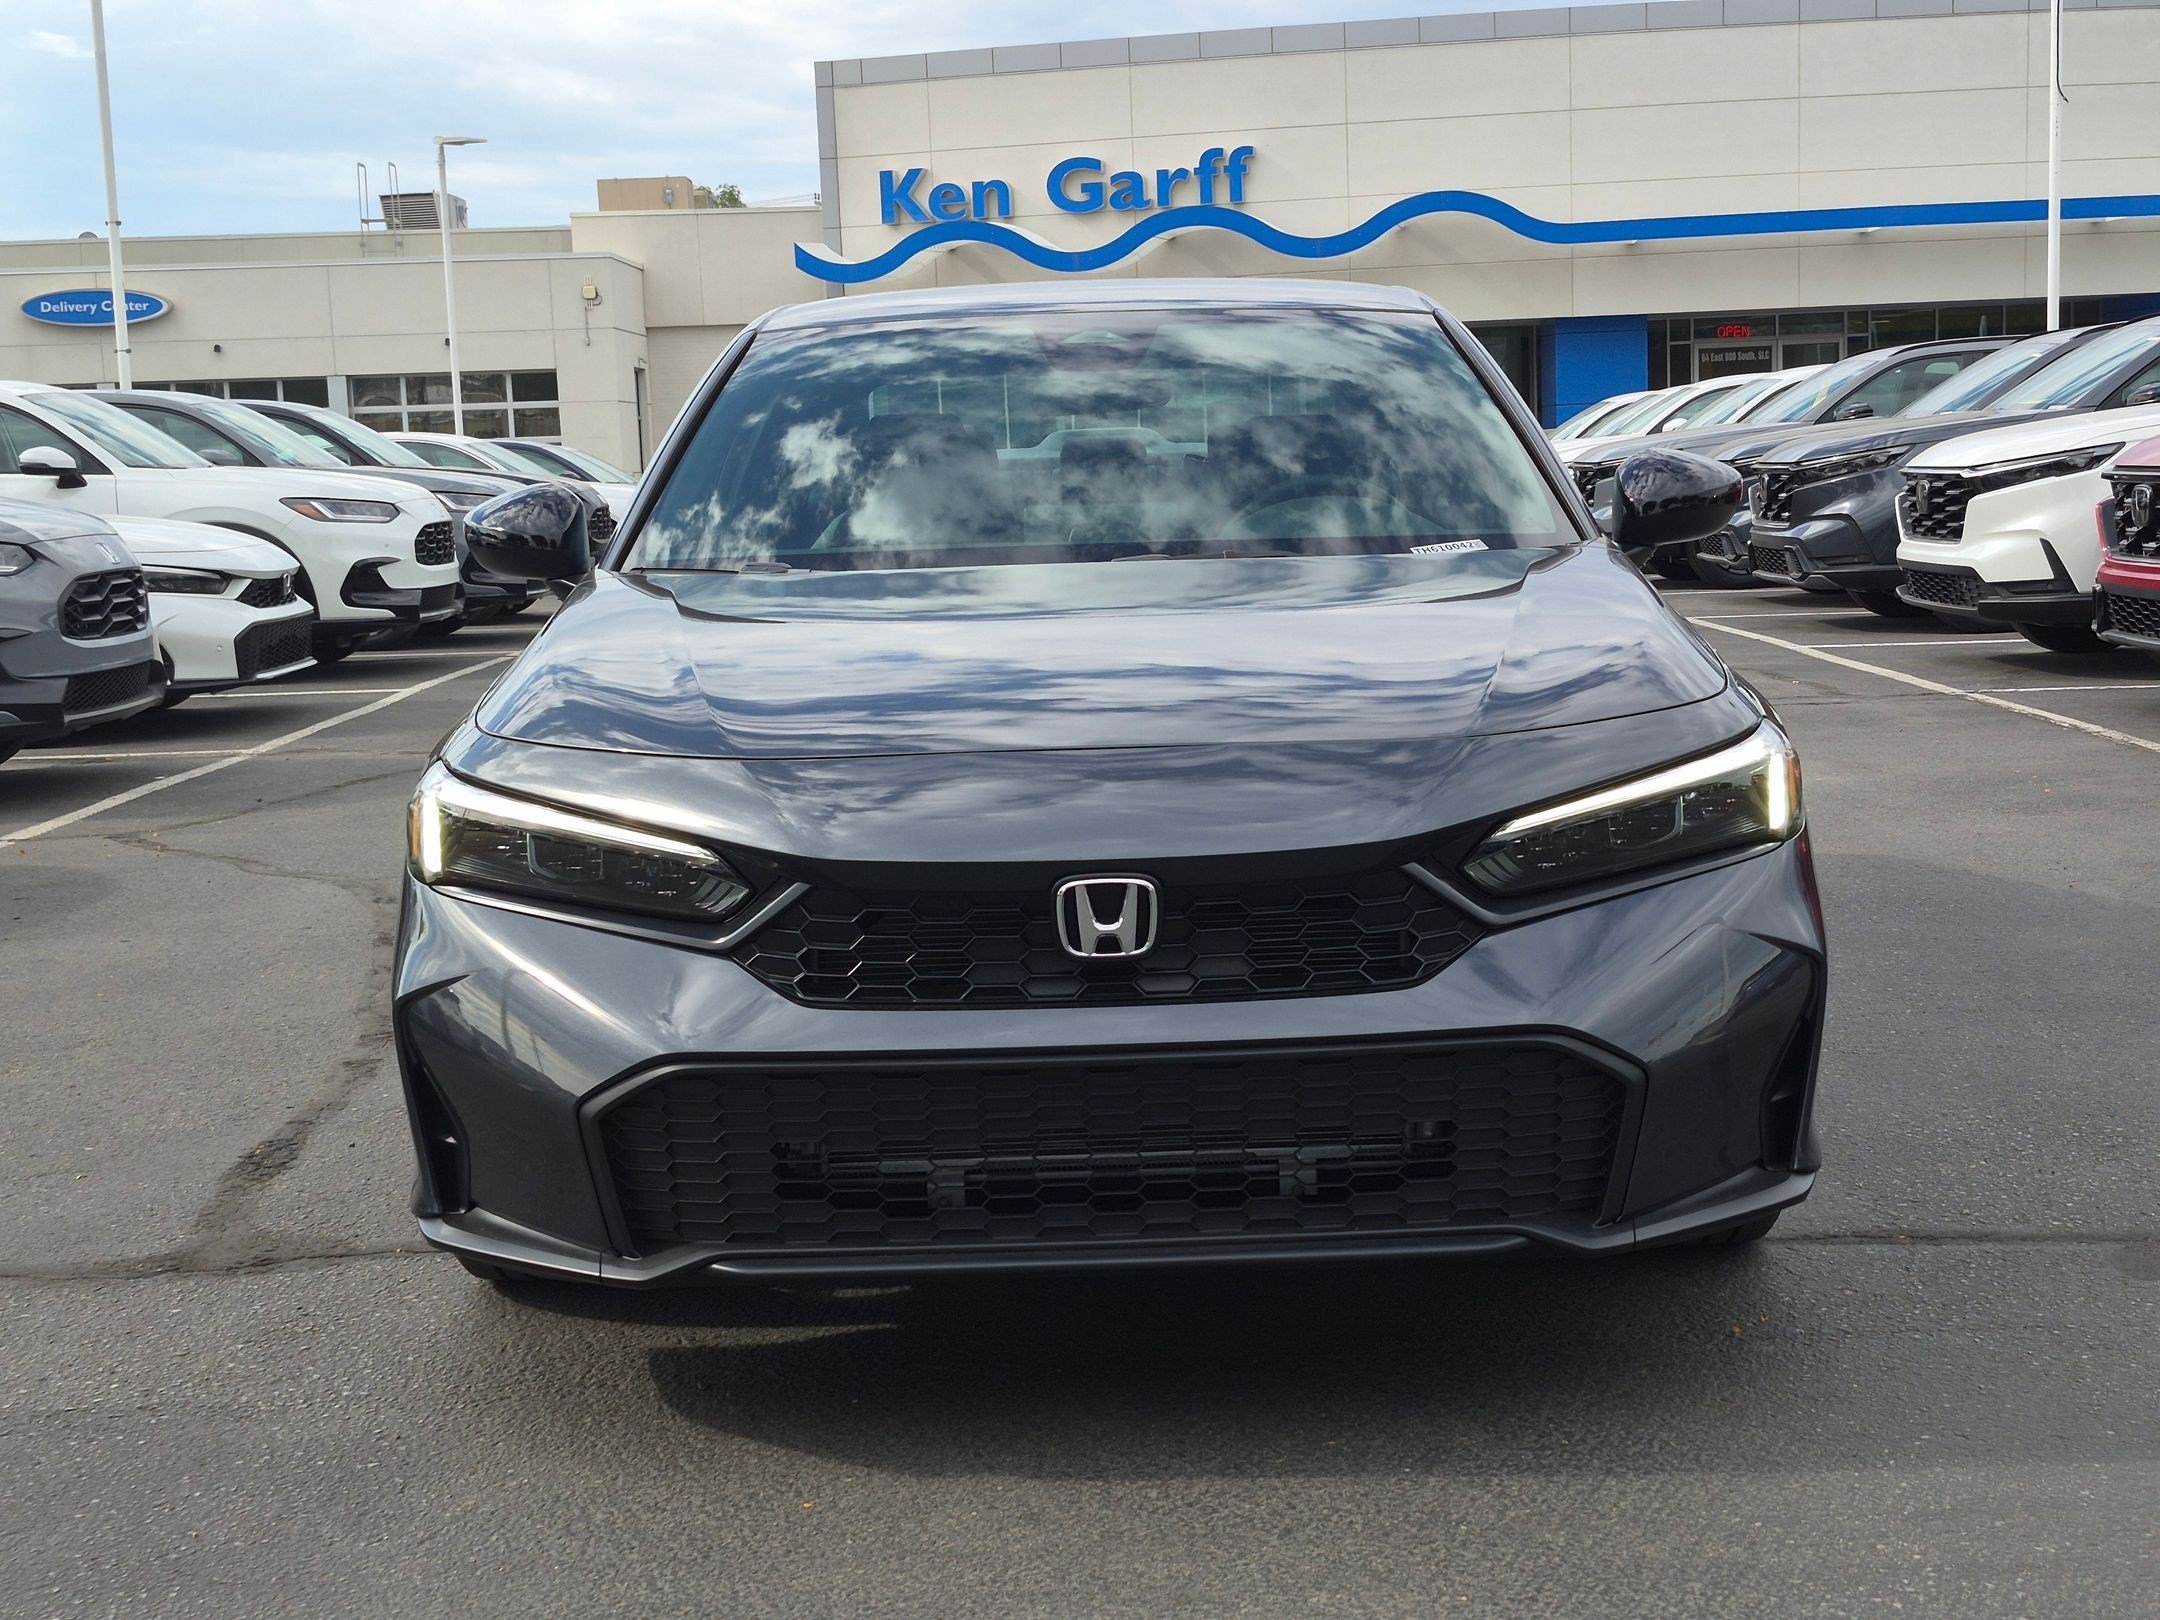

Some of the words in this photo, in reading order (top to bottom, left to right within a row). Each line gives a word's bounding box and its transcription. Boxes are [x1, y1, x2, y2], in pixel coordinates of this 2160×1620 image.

[879, 167, 1014, 225] Ken
[1046, 145, 1256, 215] Garff
[40, 301, 97, 315] Delivery
[101, 300, 149, 312] Cter
[1717, 325, 1750, 337] OPEN
[1711, 352, 1724, 362] East
[1758, 350, 1770, 360] SLC
[1414, 541, 1474, 554] TH610042
